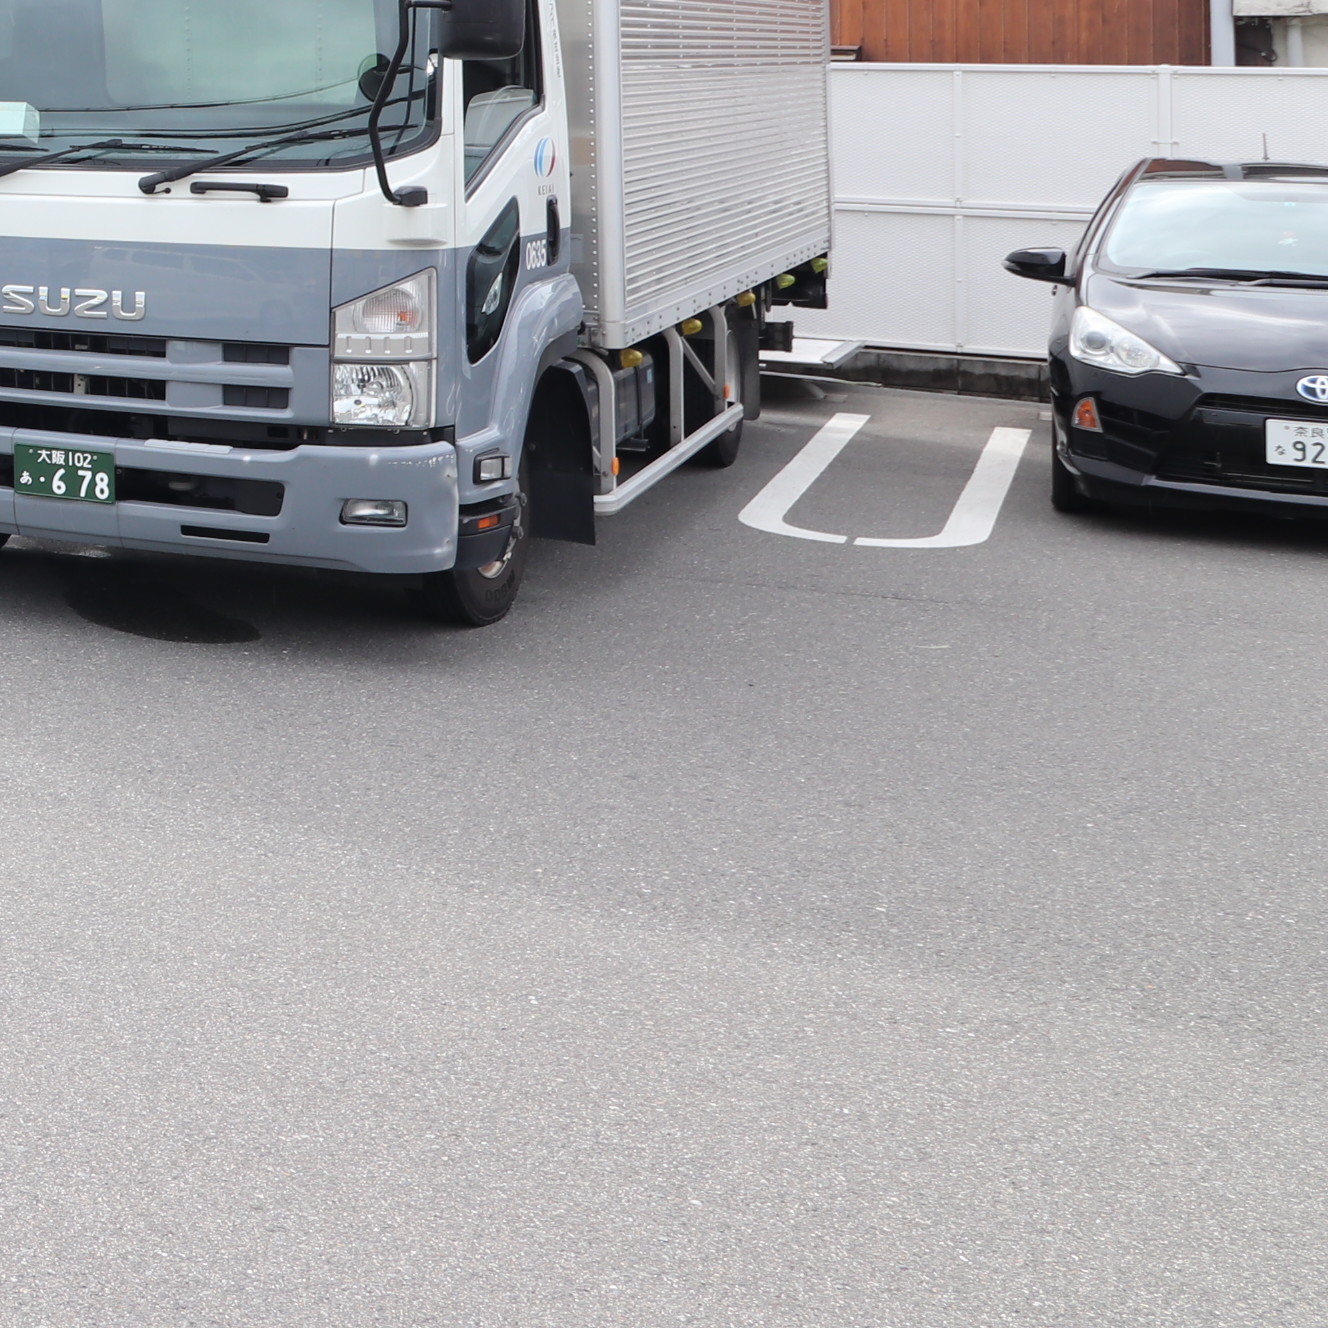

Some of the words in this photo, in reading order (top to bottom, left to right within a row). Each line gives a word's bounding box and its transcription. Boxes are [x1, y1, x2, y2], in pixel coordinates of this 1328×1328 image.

[1294, 426, 1328, 439] 奈良
[1274, 444, 1286, 456] な
[37, 449, 92, 468] 大阪102
[19, 470, 33, 486] あ
